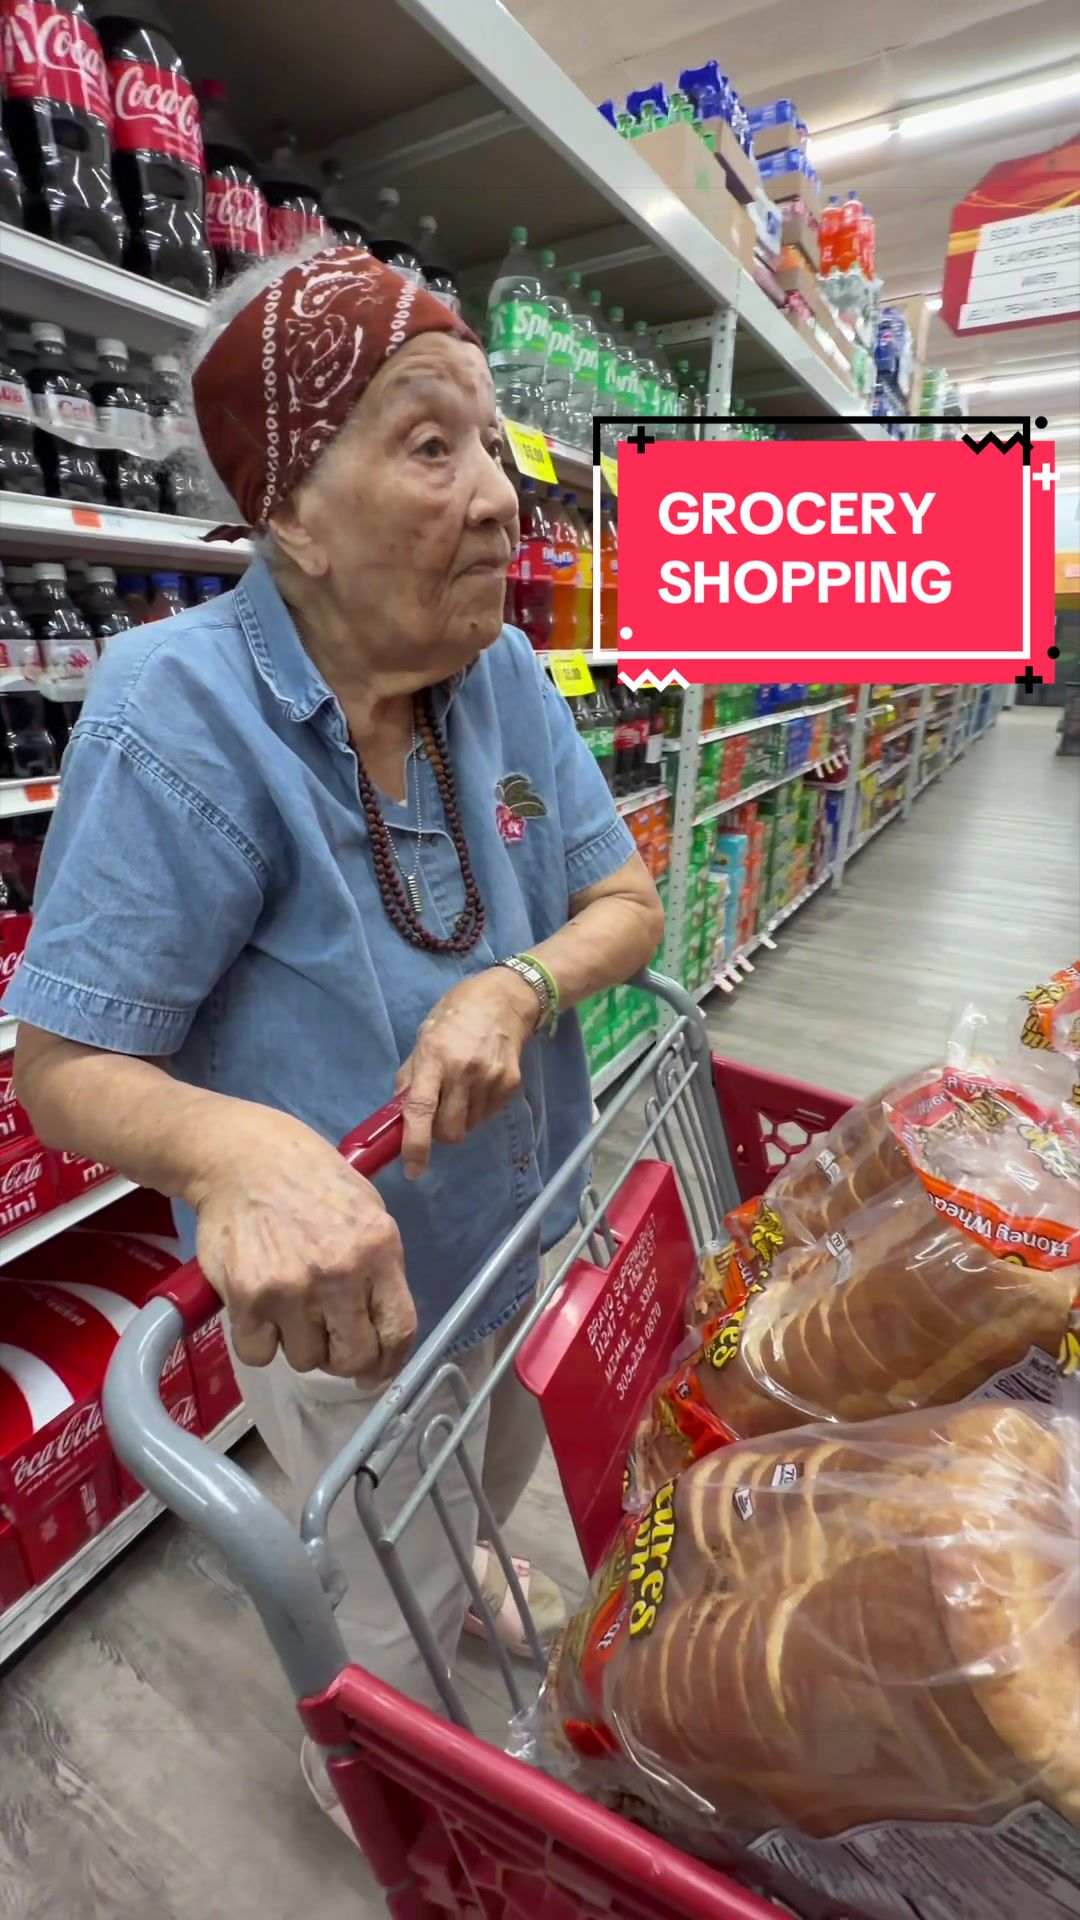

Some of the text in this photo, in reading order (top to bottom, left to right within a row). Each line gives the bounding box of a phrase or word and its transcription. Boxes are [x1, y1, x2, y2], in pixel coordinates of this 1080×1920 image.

[587, 1213, 656, 1346] BRAVO SUPERMARKET
[995, 1224, 1070, 1258] Honey
